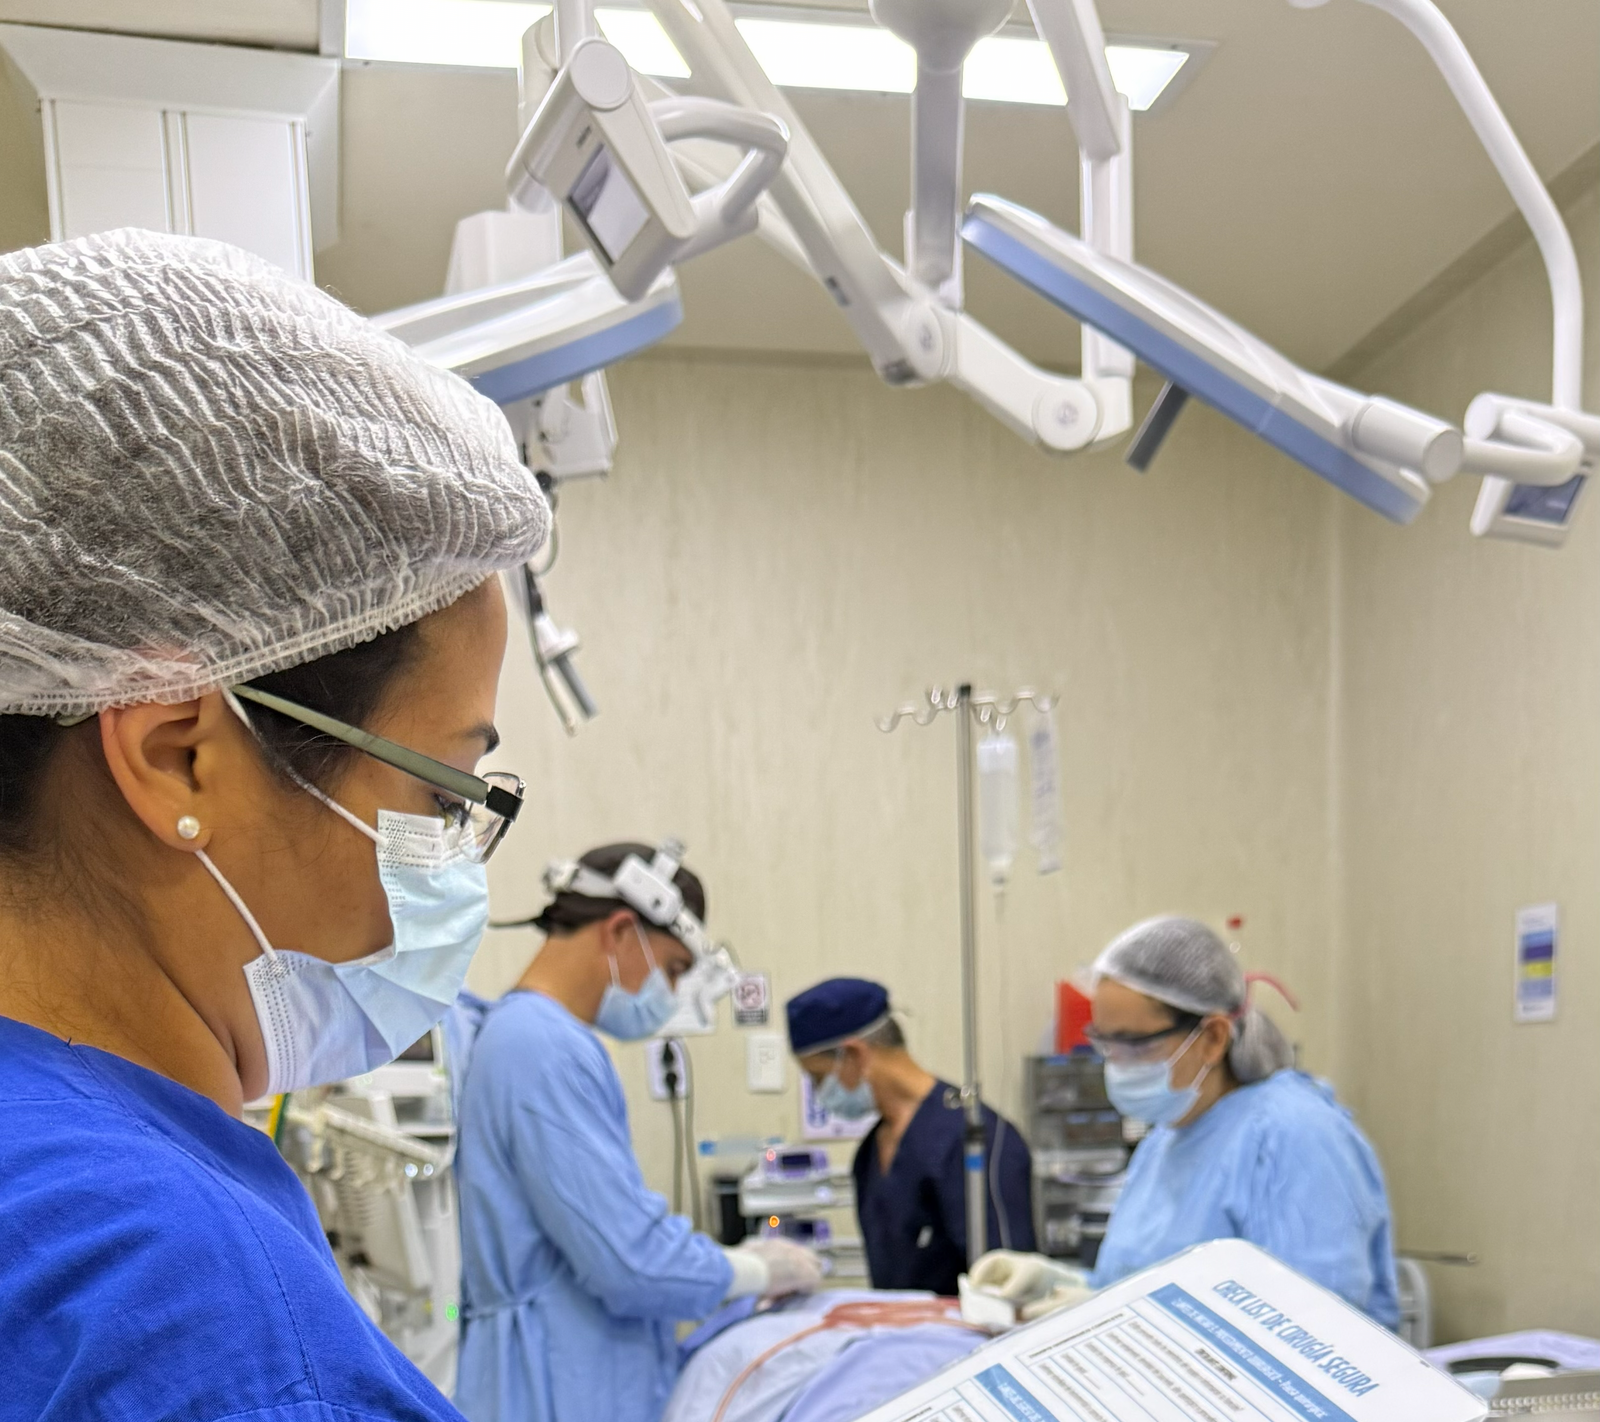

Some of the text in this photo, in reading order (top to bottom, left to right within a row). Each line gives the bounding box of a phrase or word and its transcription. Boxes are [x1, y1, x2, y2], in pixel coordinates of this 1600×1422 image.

[1212, 1279, 1258, 1307] CHECK
[1239, 1298, 1278, 1320] LIST
[1259, 1313, 1292, 1331] DE
[1275, 1325, 1336, 1364] CIRUGÍA
[1317, 1356, 1380, 1398] SEGURA
